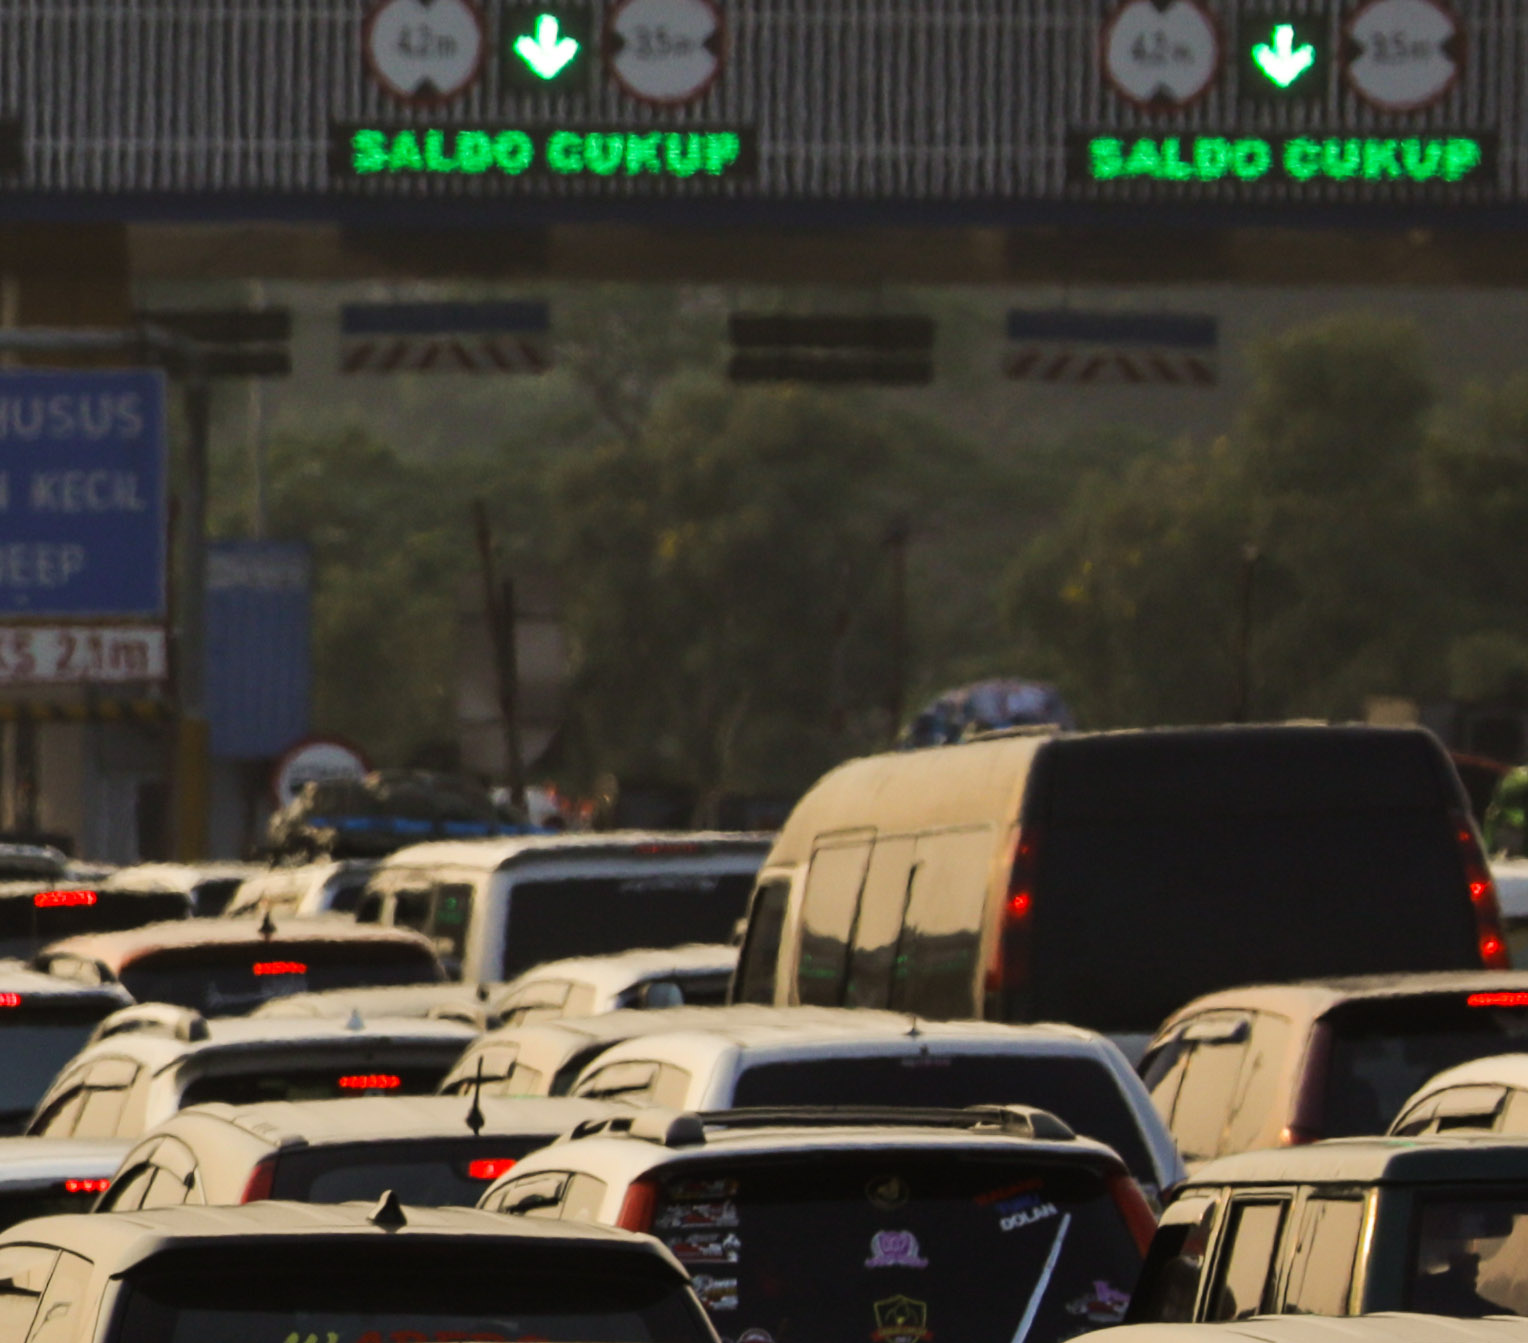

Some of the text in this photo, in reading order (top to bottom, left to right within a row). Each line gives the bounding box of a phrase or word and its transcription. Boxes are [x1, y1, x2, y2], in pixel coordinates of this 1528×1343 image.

[352, 129, 740, 178] SALDO CUKUP
[1089, 136, 1480, 182] SALDO CUKUP
[30, 470, 147, 514] KECIL
